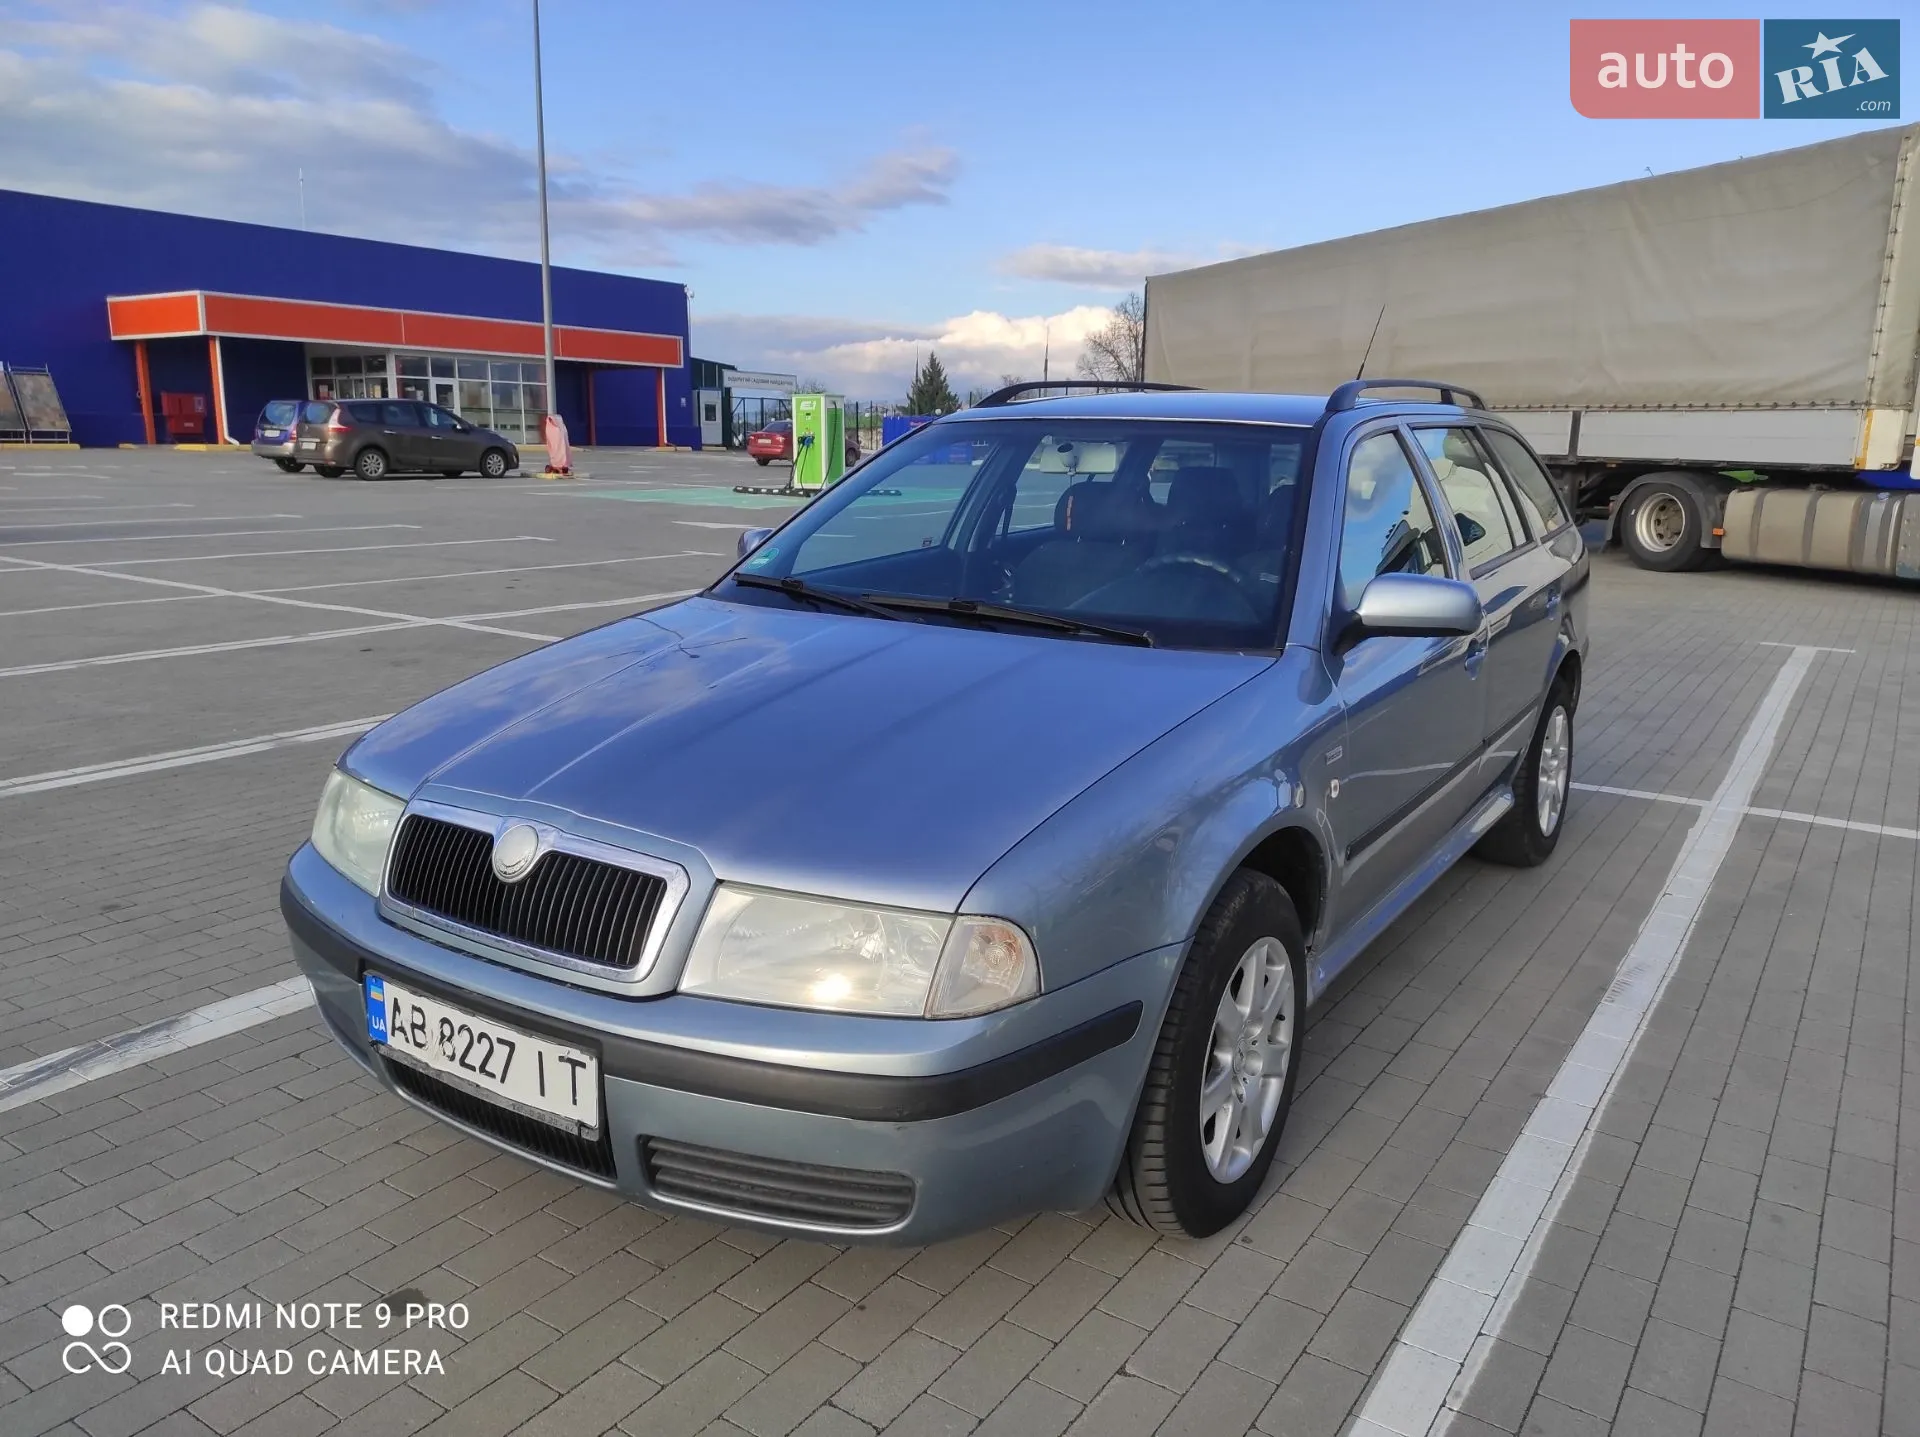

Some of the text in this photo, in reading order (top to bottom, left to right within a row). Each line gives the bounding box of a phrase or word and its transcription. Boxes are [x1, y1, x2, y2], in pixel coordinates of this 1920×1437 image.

[372, 1014, 386, 1032] UA
[390, 997, 587, 1106] AB 8227 IT
